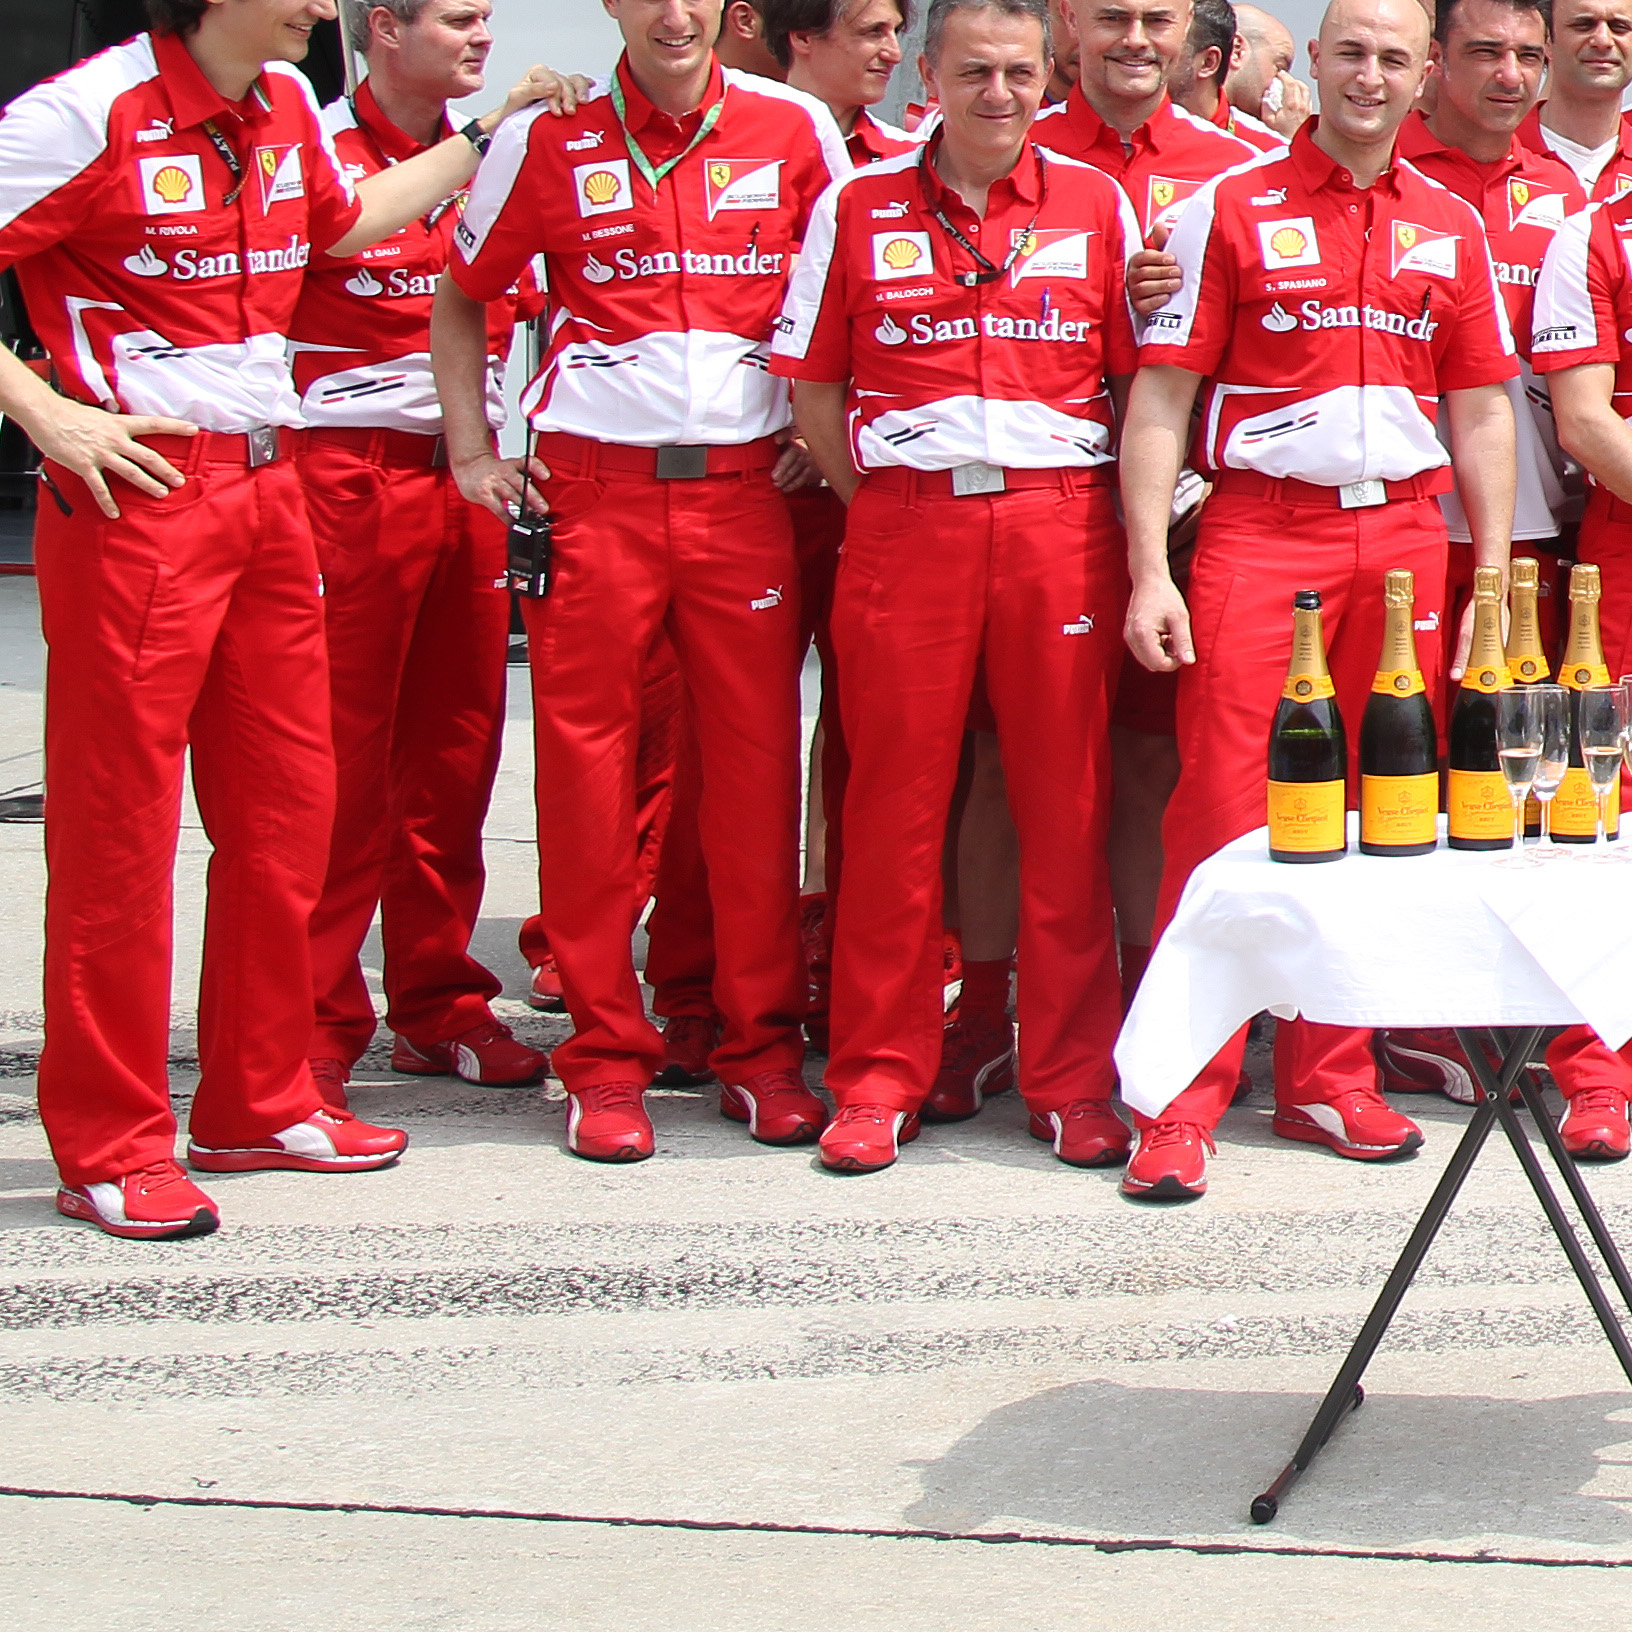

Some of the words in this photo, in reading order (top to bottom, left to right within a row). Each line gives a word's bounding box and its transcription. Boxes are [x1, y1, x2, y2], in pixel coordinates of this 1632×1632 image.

[158, 225, 198, 236] RIVOLA
[592, 224, 635, 239] BESSONE
[173, 234, 312, 280] Santander
[374, 247, 401, 257] GALLI
[614, 244, 784, 280] Santander
[1277, 278, 1327, 290] SPASIANO
[886, 287, 934, 300] BALOCCHI
[910, 308, 1090, 345] Santander
